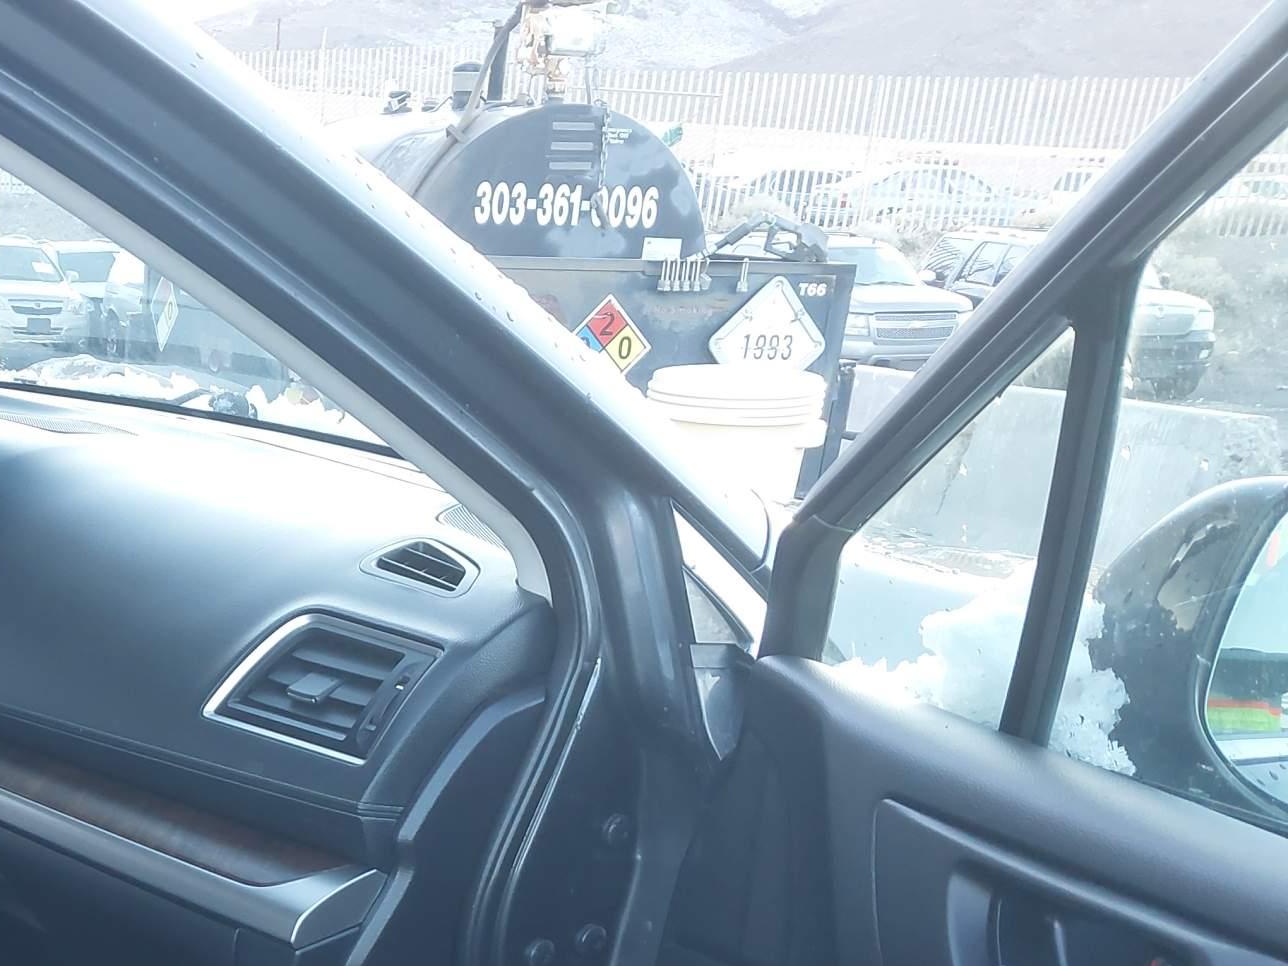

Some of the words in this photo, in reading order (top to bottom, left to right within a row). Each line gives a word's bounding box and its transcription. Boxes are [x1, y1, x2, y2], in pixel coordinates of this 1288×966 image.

[474, 181, 659, 229] 303-361-0096
[799, 283, 827, 296] T66
[618, 336, 632, 359] 0
